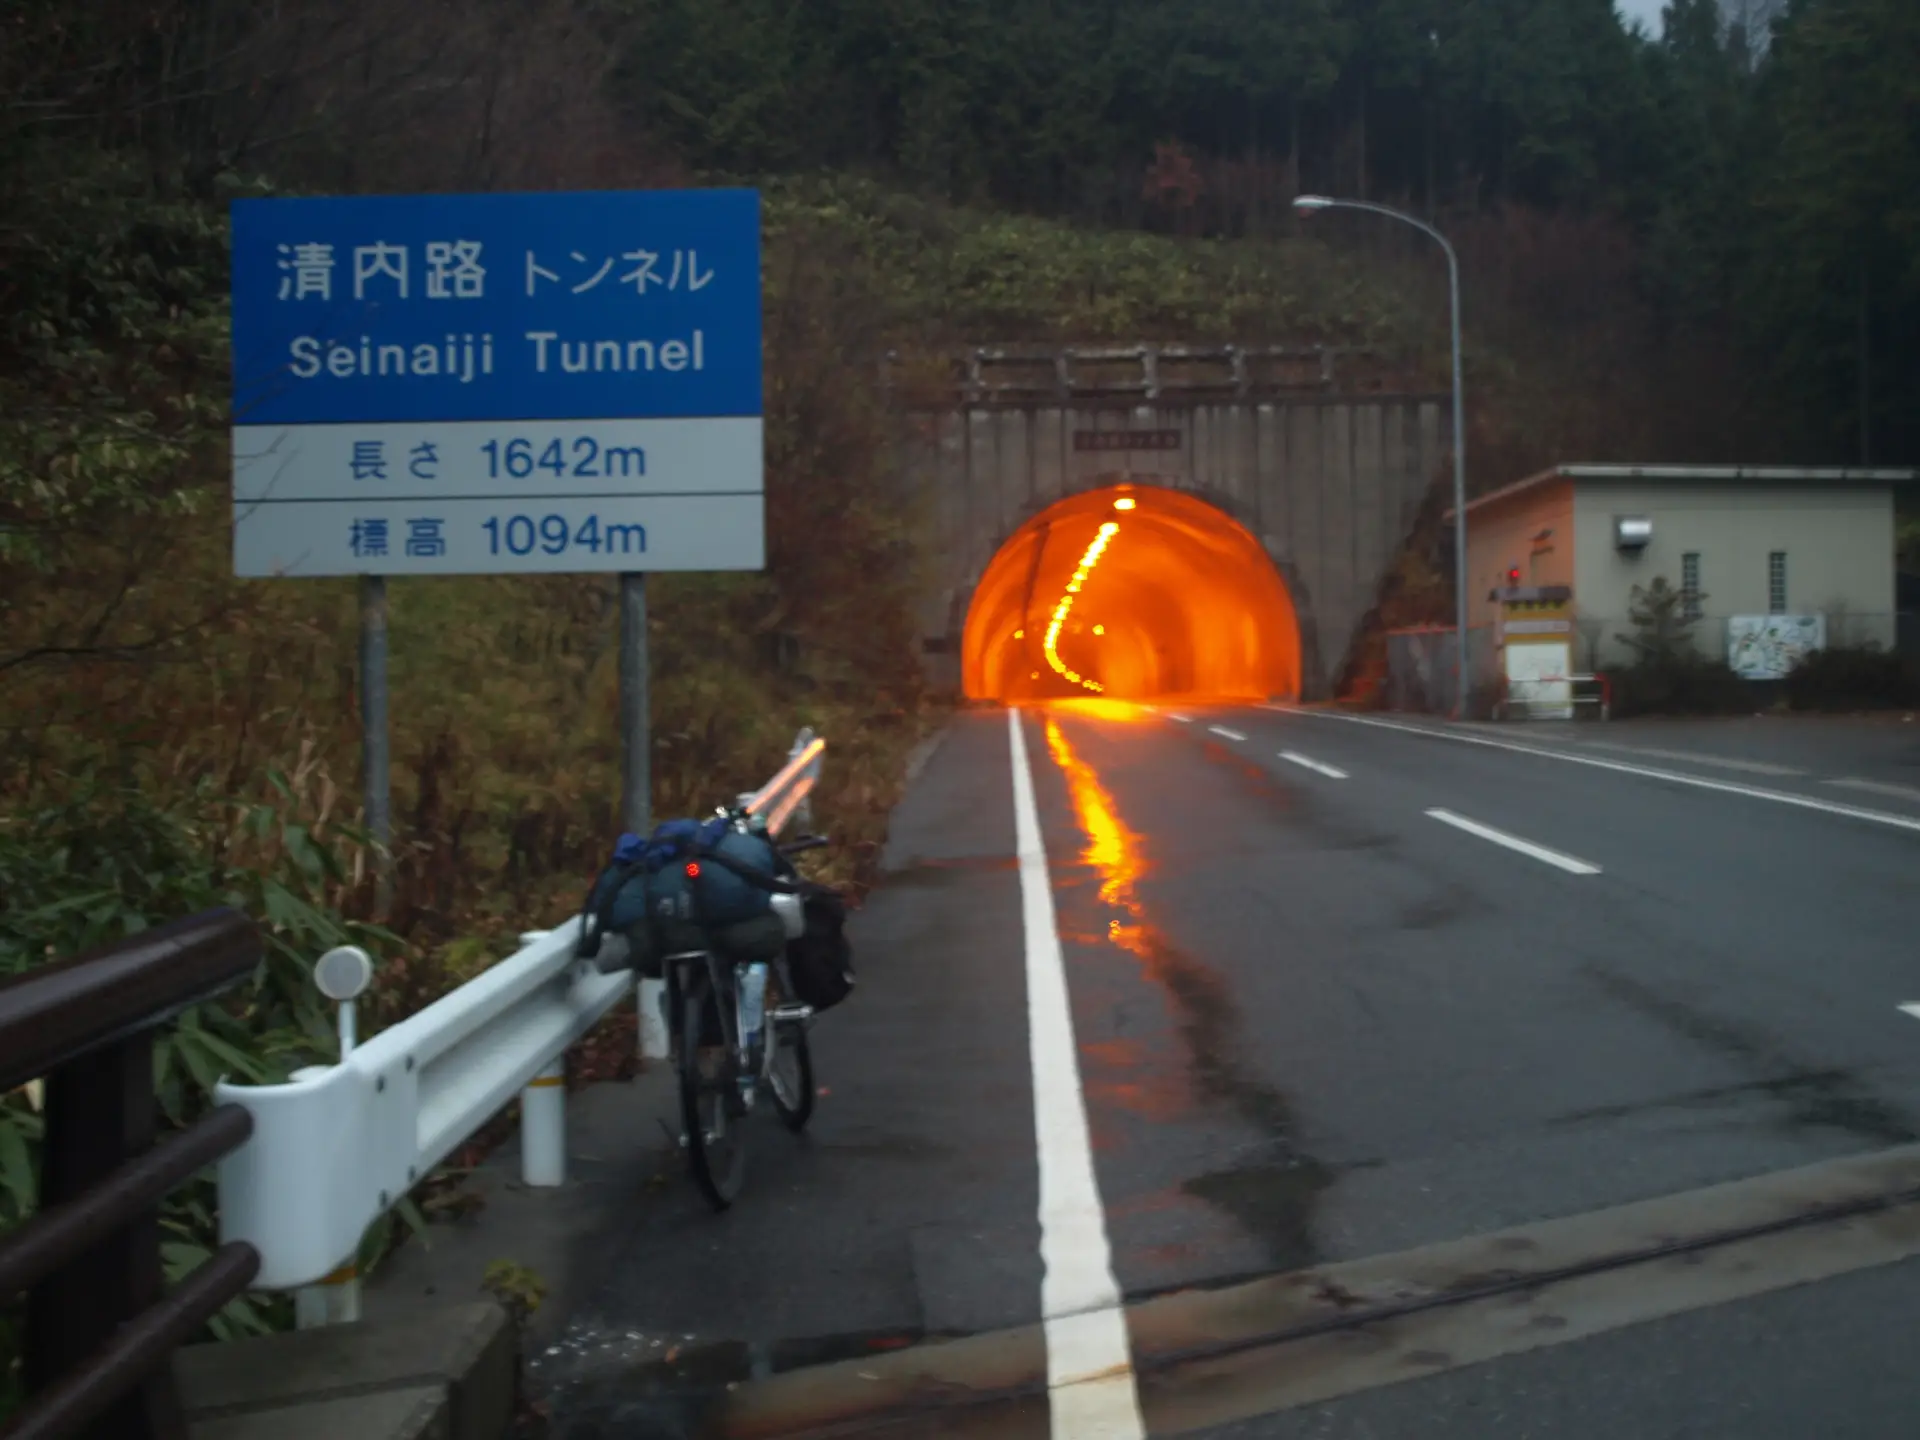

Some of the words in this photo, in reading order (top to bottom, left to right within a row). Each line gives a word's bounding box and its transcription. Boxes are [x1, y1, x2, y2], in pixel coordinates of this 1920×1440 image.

[277, 239, 487, 301] 清内路
[525, 248, 714, 297] トンネル
[289, 334, 493, 383] Seinaiji
[525, 330, 704, 373] Tunnel
[348, 440, 439, 481] 長さ
[480, 436, 646, 479] 1642m
[348, 517, 446, 558] 標高
[481, 513, 647, 557] 1094m
